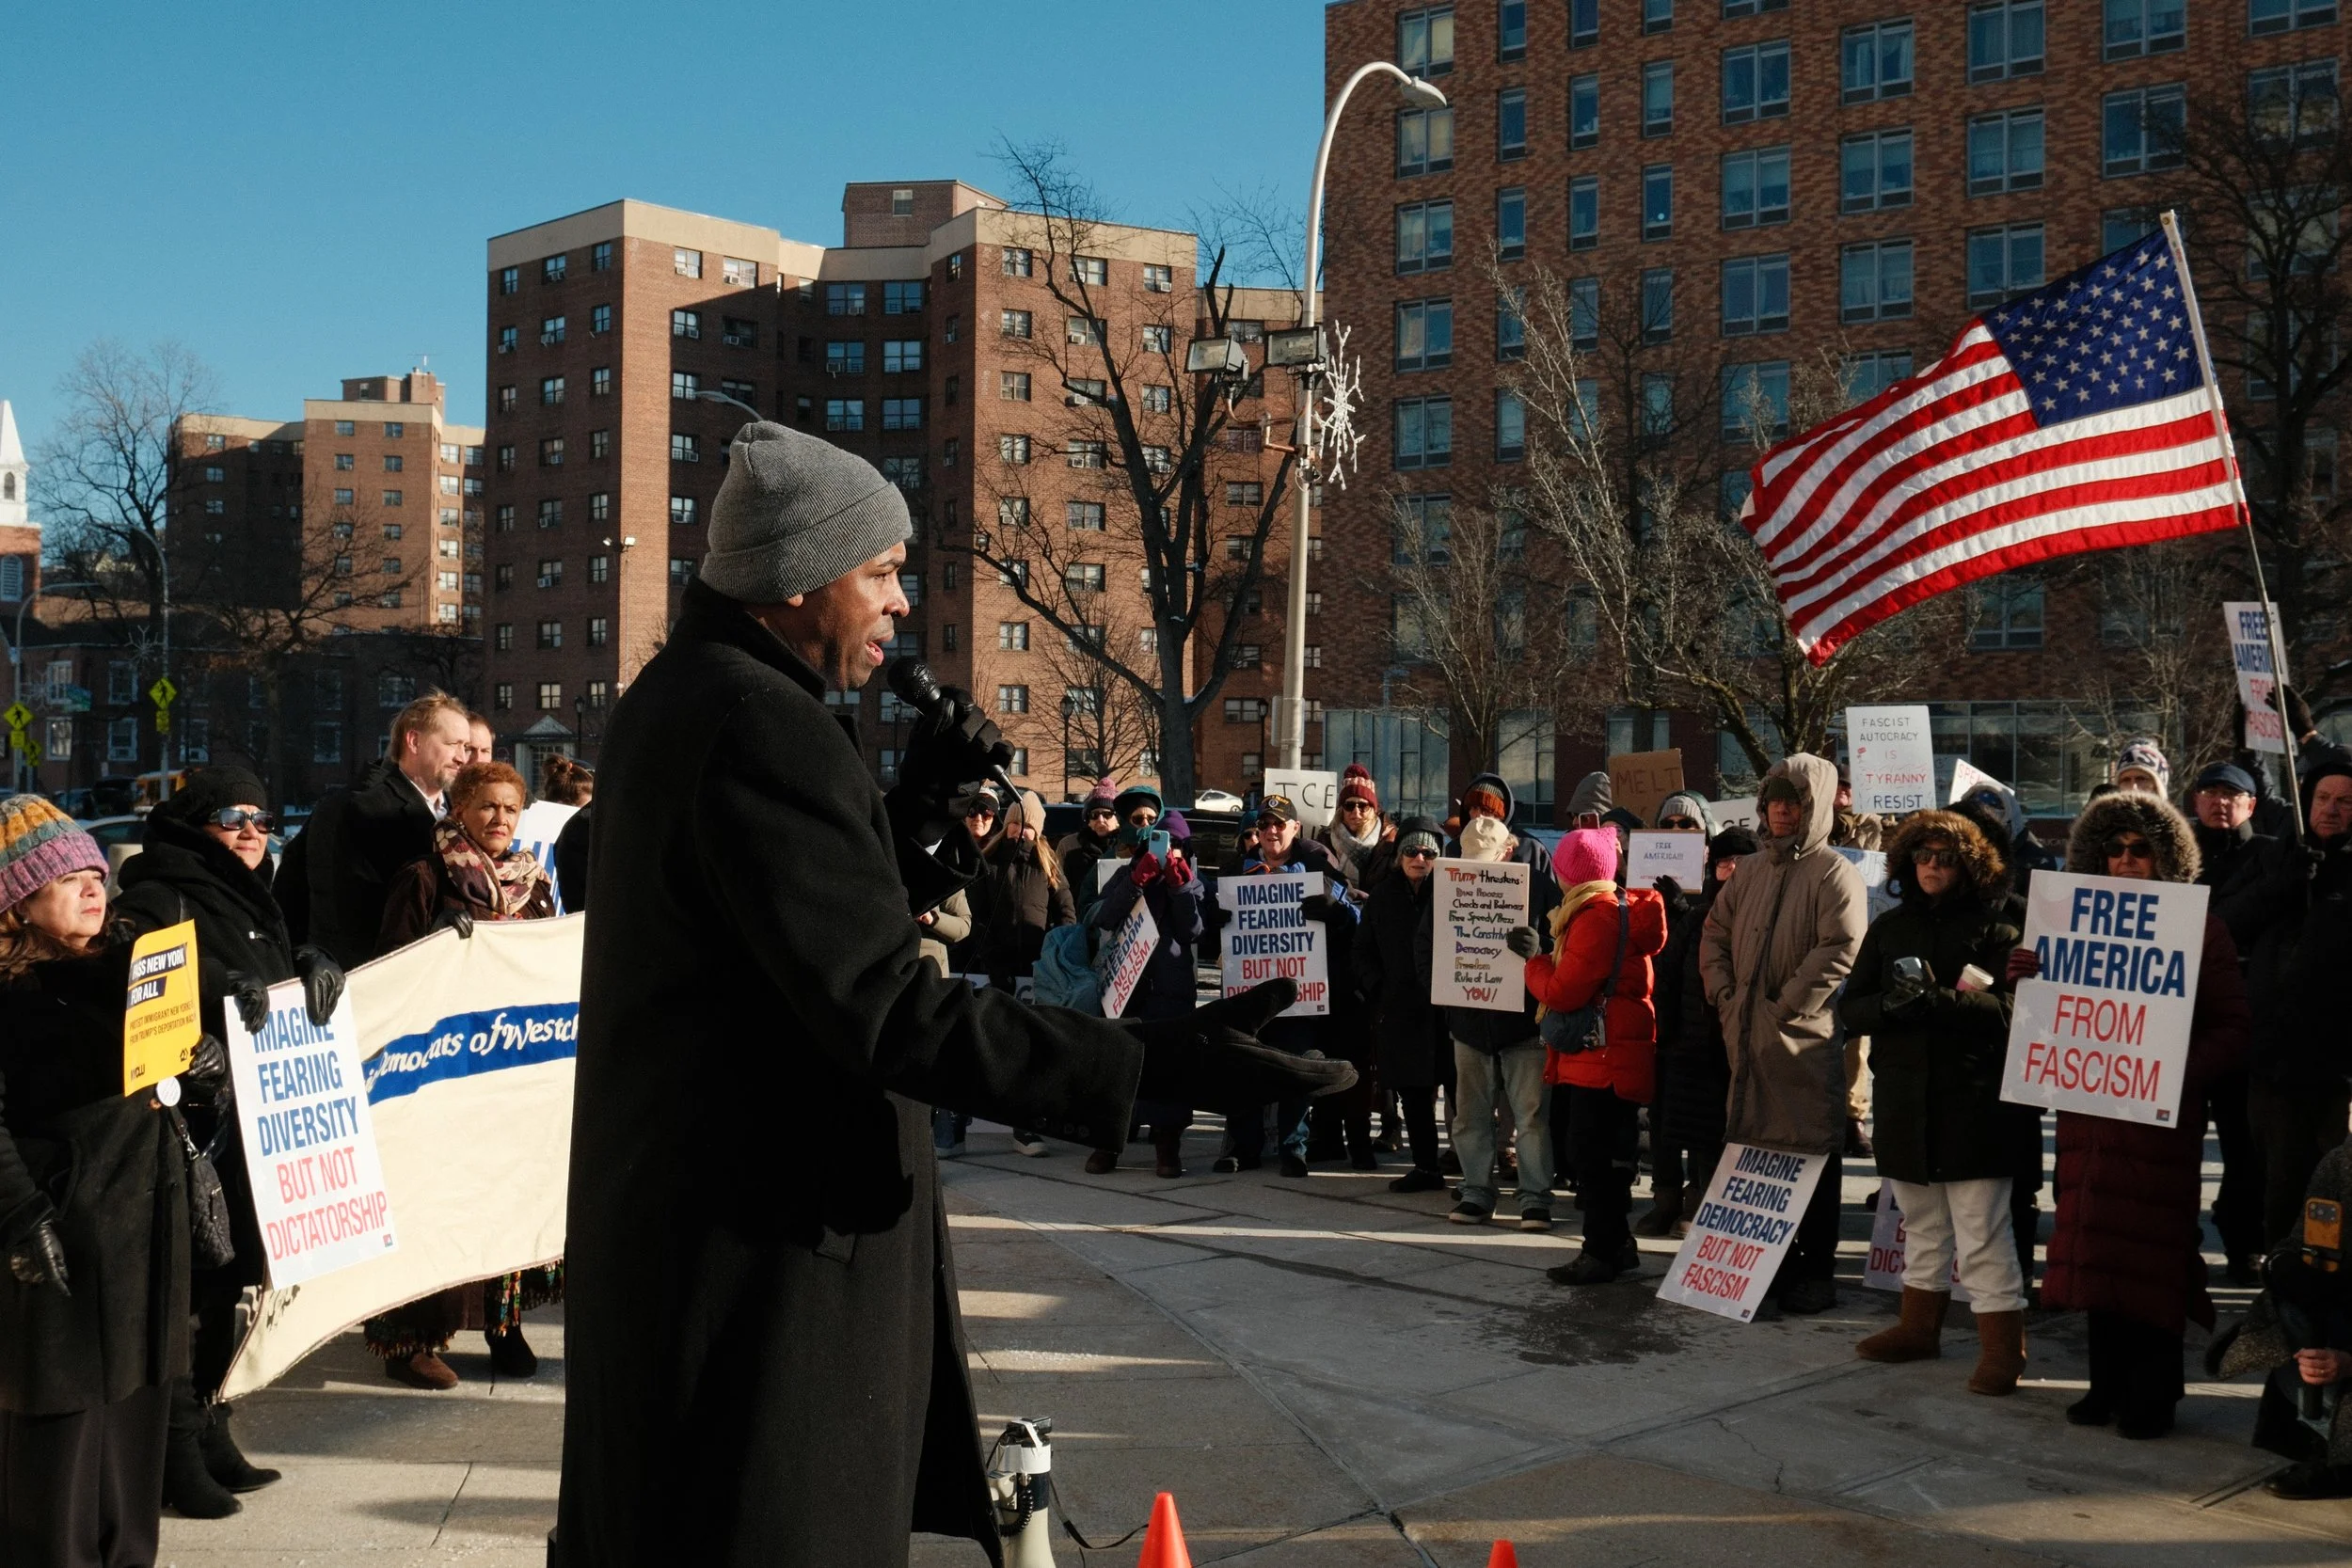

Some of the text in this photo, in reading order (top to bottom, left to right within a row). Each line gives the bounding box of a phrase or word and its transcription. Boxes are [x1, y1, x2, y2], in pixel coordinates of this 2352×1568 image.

[2234, 643, 2282, 675] AMERI
[1862, 717, 1911, 727] FASCIST
[2245, 709, 2282, 740] FASCIS
[1859, 732, 1919, 742] AUTOCRACY
[1884, 750, 1898, 760] IS
[1614, 767, 1680, 795] MELT
[1866, 773, 1927, 784] TYRANNY
[1873, 795, 1924, 809] RESIST
[1444, 867, 1477, 885] Trump
[1236, 881, 1305, 906] IMAGINE
[1452, 898, 1525, 911] Checks and Balances
[1238, 908, 1307, 930] FEARING
[1448, 910, 1466, 922] Free
[2070, 887, 2160, 941] FREE
[1232, 931, 1315, 956] DIVERSITY
[1454, 926, 1471, 938] The
[146, 953, 167, 974] NEW
[167, 947, 185, 968] YORK
[1454, 957, 1491, 970] Freedom
[1455, 941, 1502, 959] Democracy
[1112, 939, 1151, 1016] FASCISM
[1113, 940, 1140, 993] NO TO
[1242, 957, 1307, 980] BUT NOT
[1454, 971, 1503, 984] Rule of Law
[2026, 935, 2185, 998] AMERICA
[131, 980, 159, 1006] FOR ALL
[2053, 993, 2147, 1046] FROM
[469, 1012, 508, 1056] of
[257, 1051, 344, 1104] FEARING
[2024, 1042, 2161, 1102] FASCISM
[257, 1096, 359, 1157] DIVERSITY
[276, 1147, 358, 1205] BUT NOT
[1734, 1147, 1807, 1183] IMAGINE
[1721, 1176, 1792, 1213] FEARING
[266, 1191, 388, 1261] DICTATORSHIP
[1695, 1202, 1796, 1246] DEMOCRACY
[1696, 1234, 1765, 1272] BUT NOT
[1680, 1262, 1751, 1303] FASCISM
